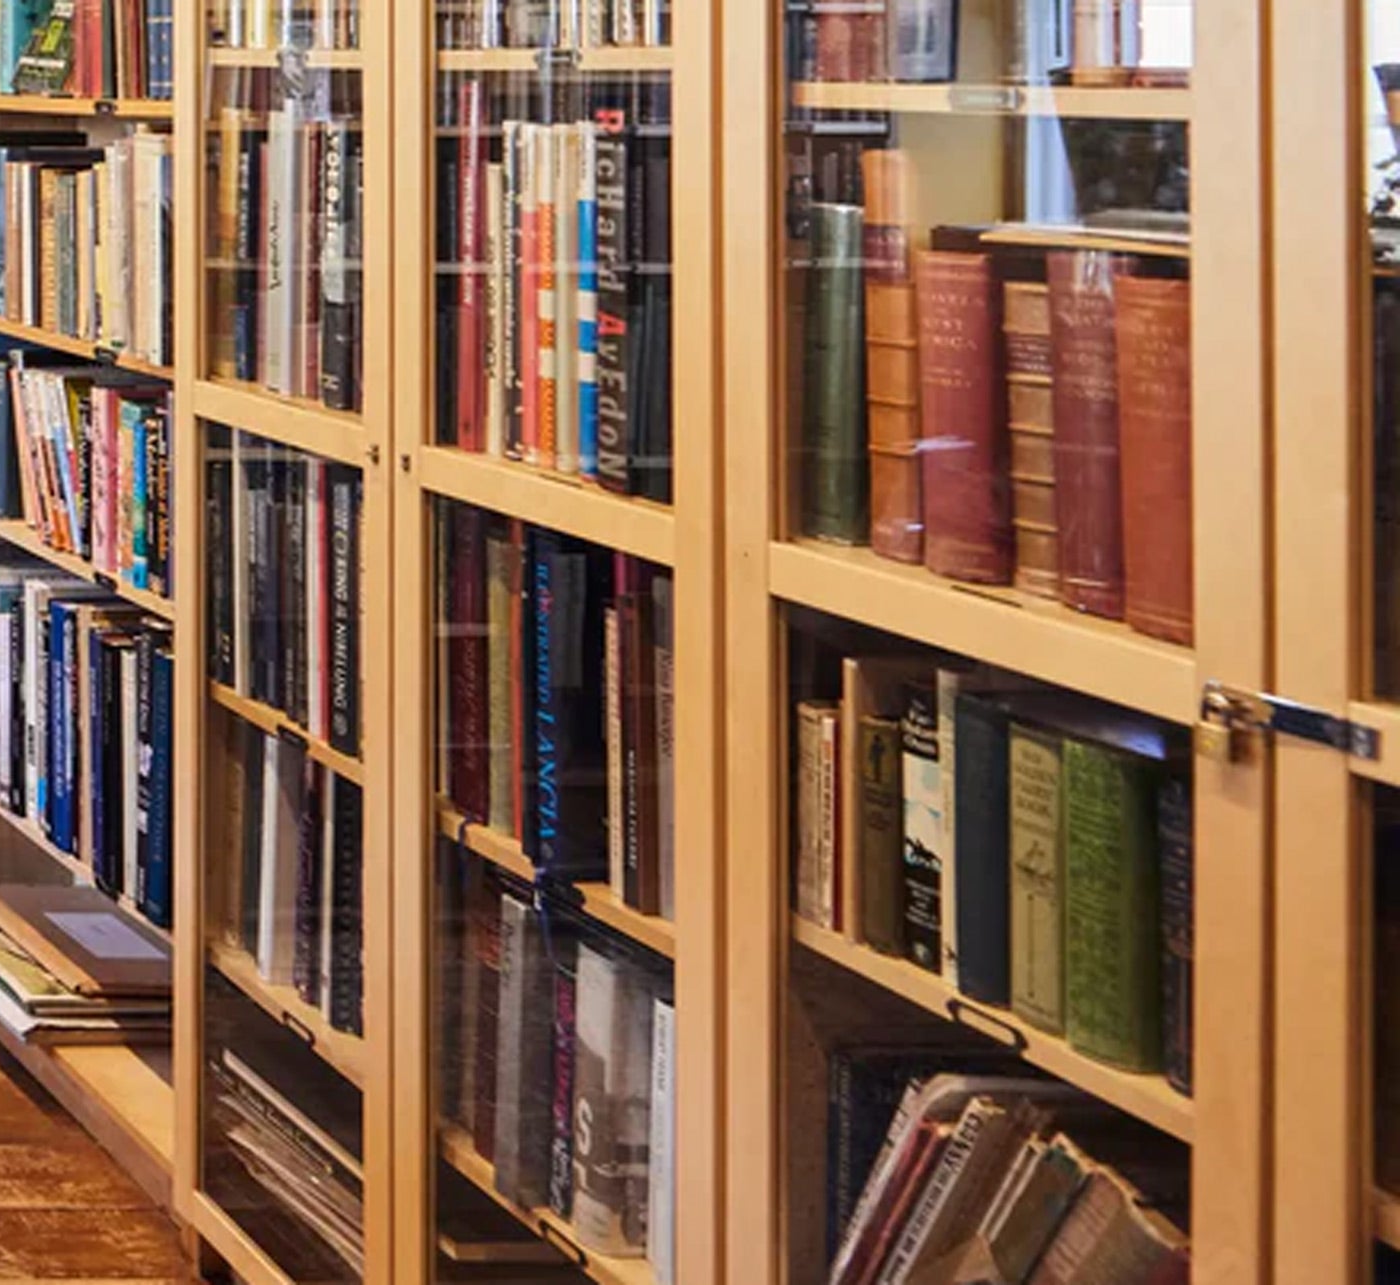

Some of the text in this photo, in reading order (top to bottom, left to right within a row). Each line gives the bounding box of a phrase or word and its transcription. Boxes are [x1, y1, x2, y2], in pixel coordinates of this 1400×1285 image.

[596, 109, 627, 481] RicHard AvEdoN
[536, 709, 558, 840] LANCIA
